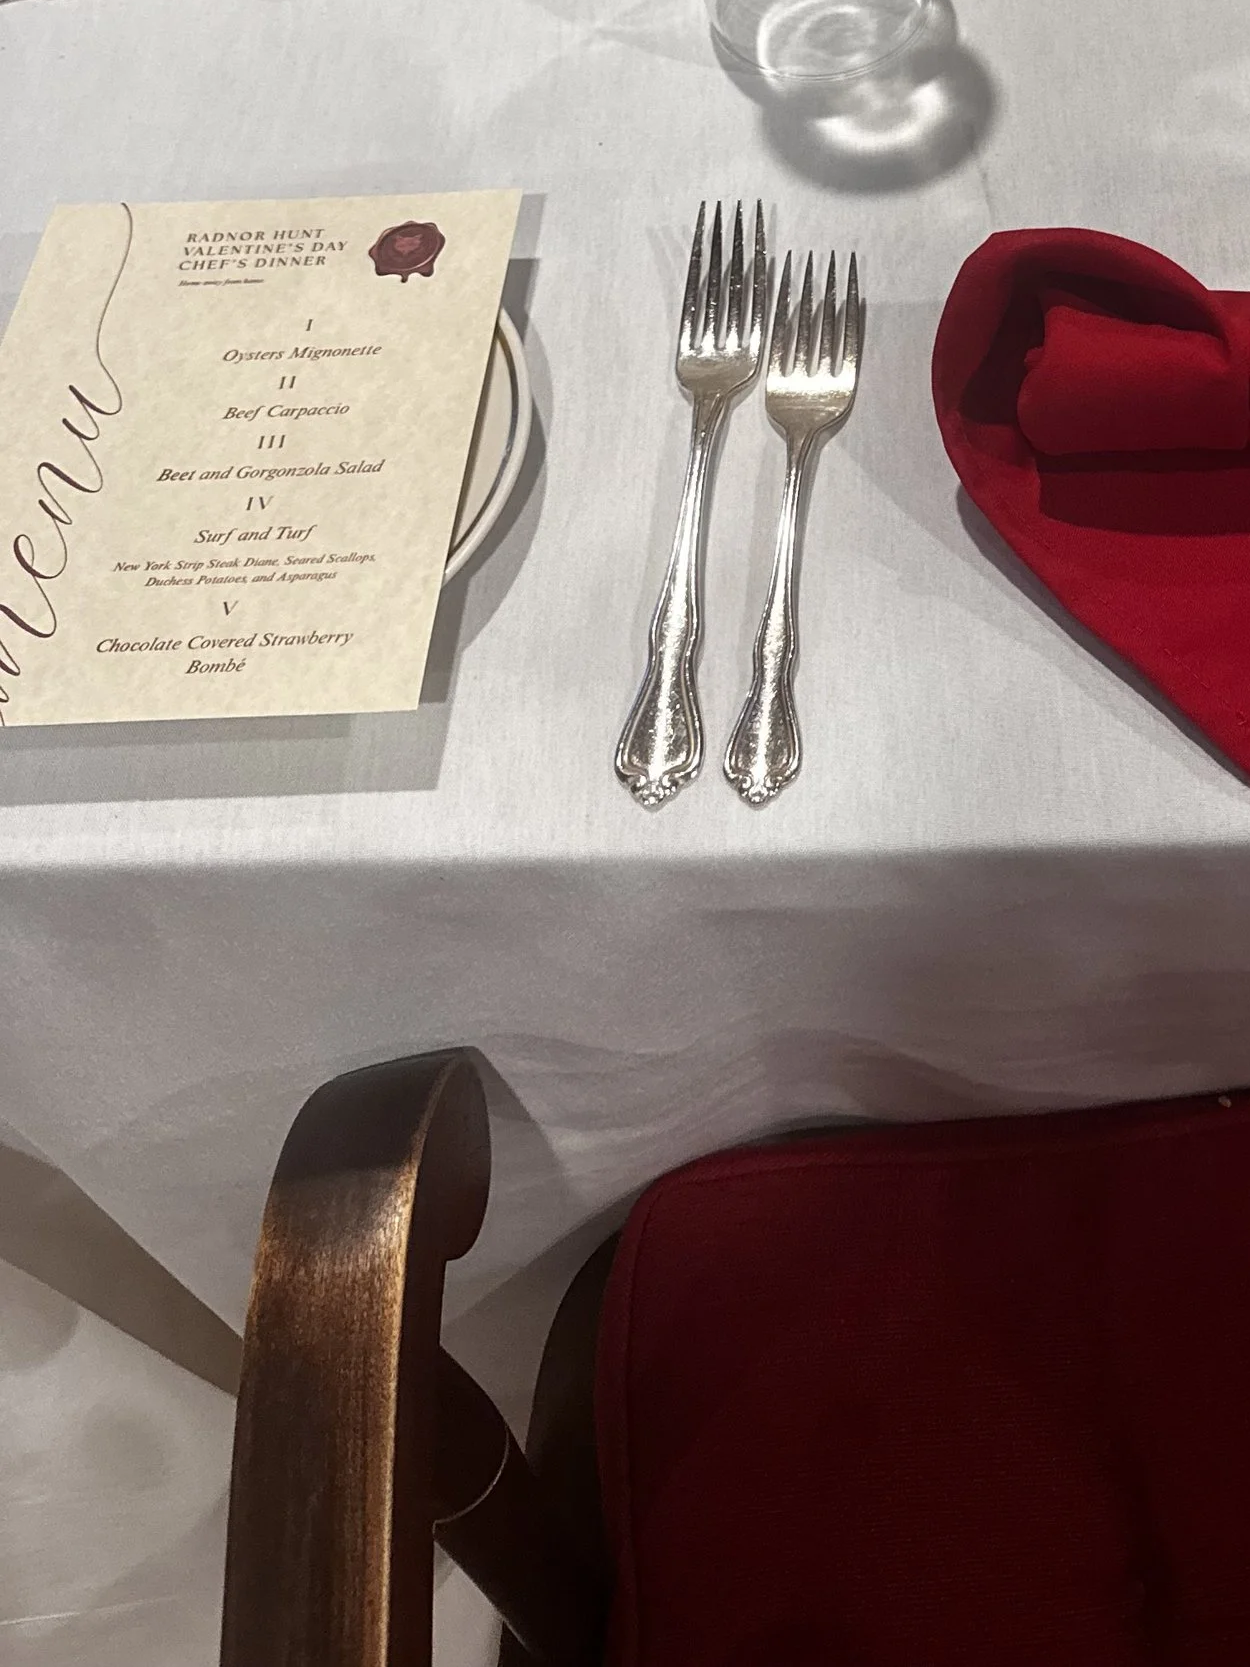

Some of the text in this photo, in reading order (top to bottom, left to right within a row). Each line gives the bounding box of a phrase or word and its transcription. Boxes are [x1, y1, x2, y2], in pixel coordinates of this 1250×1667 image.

[186, 228, 325, 243] RADNOR HUNT
[184, 241, 348, 256] VALENTINE'S DAY
[178, 255, 326, 270] CHEF'S DINNER
[306, 319, 314, 332] I
[222, 344, 383, 364] Oysters Mignonette
[279, 375, 296, 390] II
[222, 402, 350, 422] Beef Carpaccio
[257, 435, 286, 449] III
[156, 459, 386, 482] Beet and Gorgonzola Salad
[246, 495, 274, 511] IV
[193, 524, 318, 545] Surf and Turf
[112, 561, 140, 572] New
[143, 560, 171, 572] York
[173, 558, 204, 573] Strip
[206, 557, 239, 570] Steak
[284, 553, 326, 566] Seared
[144, 575, 194, 587] Duchess
[251, 571, 276, 583] and
[276, 570, 338, 583] Asparagus
[222, 600, 239, 616] V
[95, 630, 354, 653] Chocolate Covered Strawberry
[185, 658, 247, 675] Bombé
